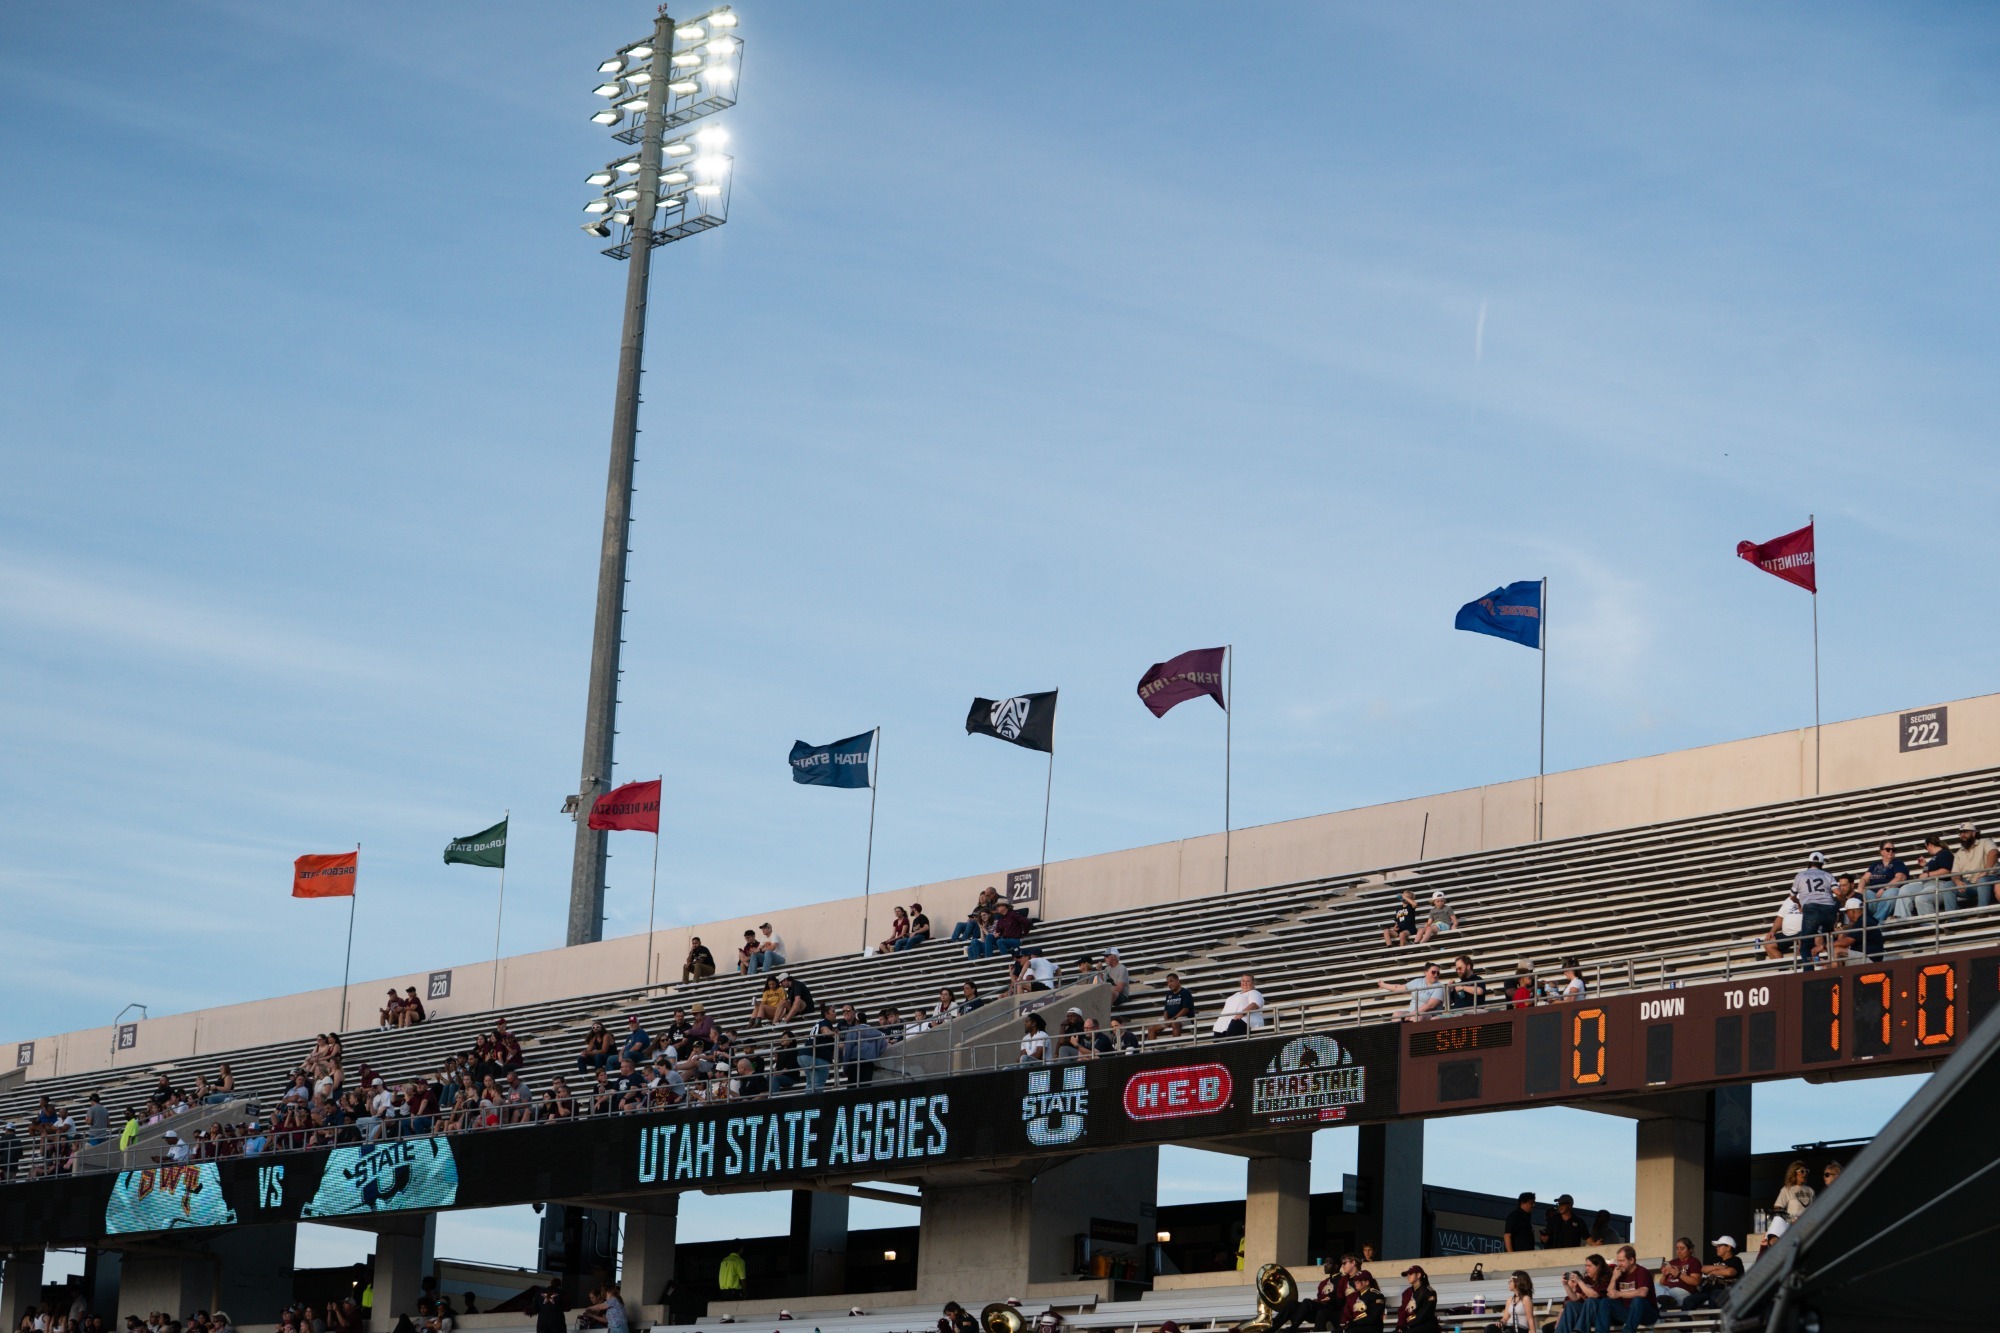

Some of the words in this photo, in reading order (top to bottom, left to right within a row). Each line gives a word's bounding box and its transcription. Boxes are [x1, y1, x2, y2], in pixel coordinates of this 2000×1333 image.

[1910, 712, 1937, 724] SECTION
[1907, 722, 1940, 747] 222
[1014, 873, 1032, 882] SECTION
[1805, 877, 1826, 893] 12
[1012, 880, 1032, 901] 221
[431, 980, 448, 997] 220
[1724, 990, 1744, 1010] TO
[1748, 986, 1770, 1007] GO
[1640, 997, 1685, 1021] DOWN
[121, 1032, 133, 1047] 219
[1436, 1026, 1482, 1051] SWT
[1573, 1008, 1606, 1084] 0
[1312, 1067, 1360, 1094] STATE
[1022, 1089, 1089, 1121] STATE
[639, 1120, 716, 1183] UTAH
[724, 1108, 821, 1175] STATE
[829, 1093, 950, 1165] AGGIES
[355, 1142, 416, 1188] STATE
[259, 1165, 284, 1208] VS
[1438, 1231, 1476, 1251] WALK
